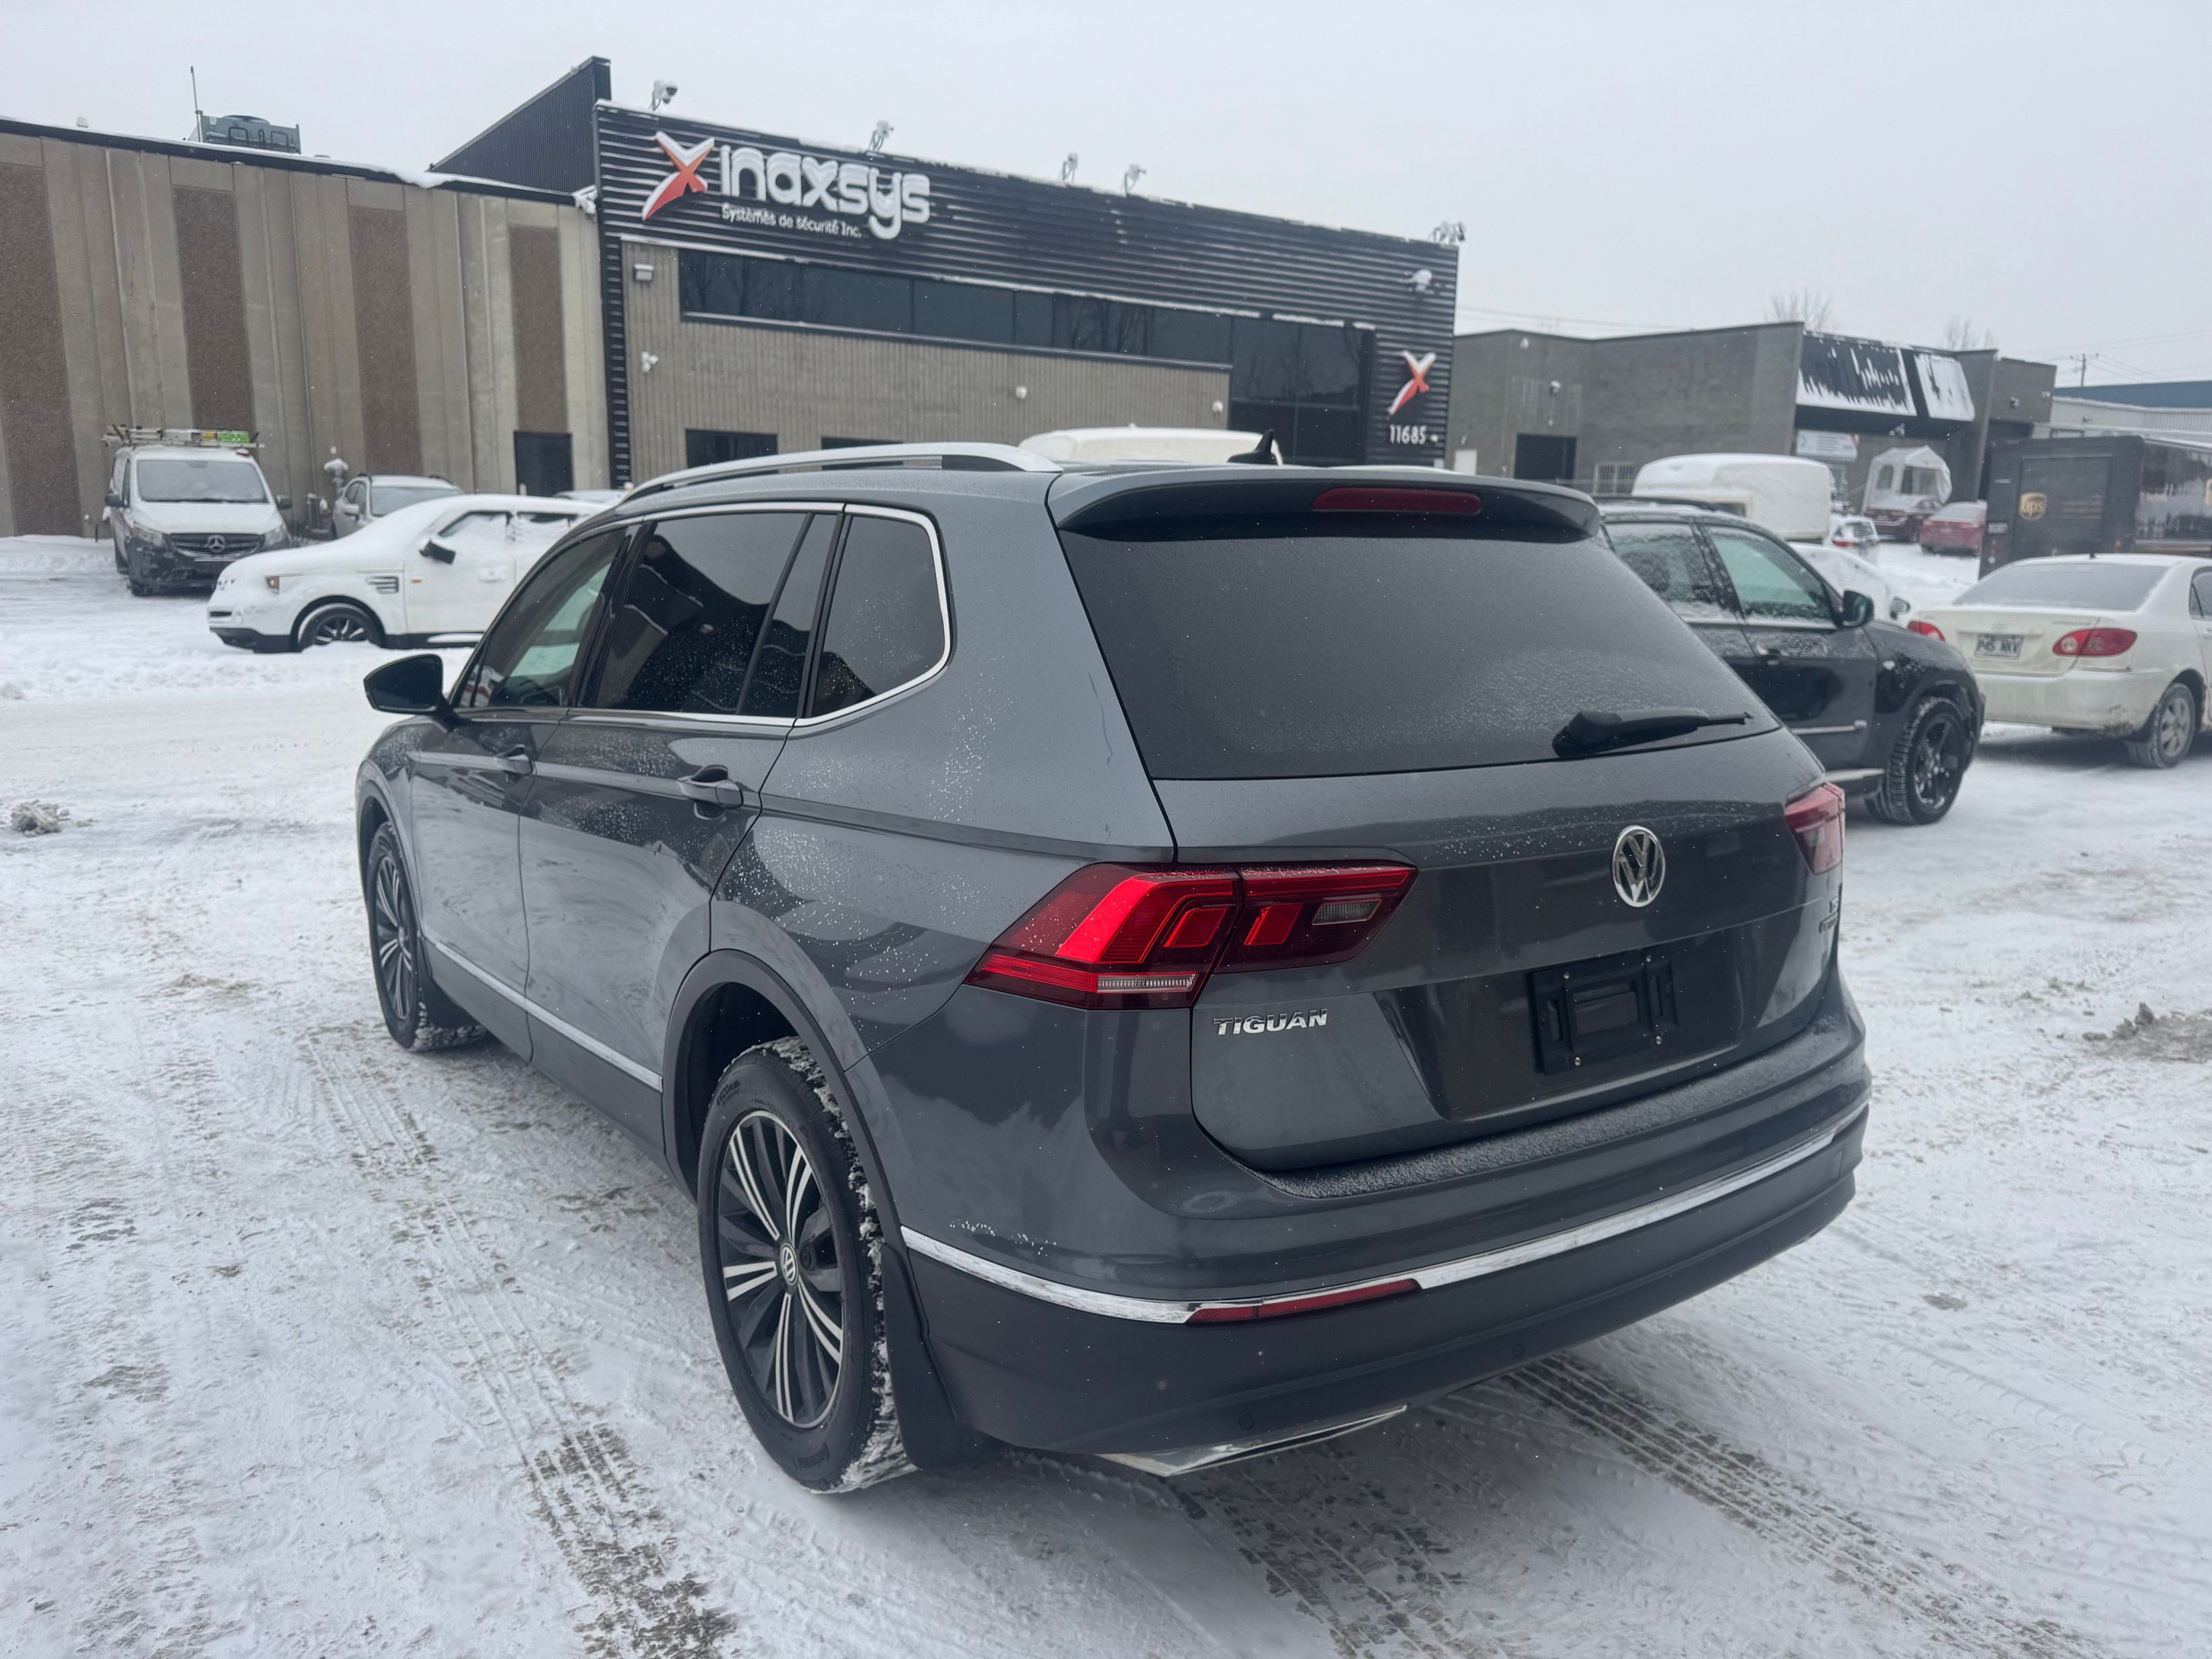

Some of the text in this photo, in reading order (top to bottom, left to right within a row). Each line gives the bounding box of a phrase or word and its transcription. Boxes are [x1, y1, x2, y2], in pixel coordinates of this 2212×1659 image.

[720, 145, 931, 239] inaxsys
[778, 213, 794, 229] de
[1389, 424, 1428, 445] 11685
[1213, 1008, 1327, 1036] TIGUAN
